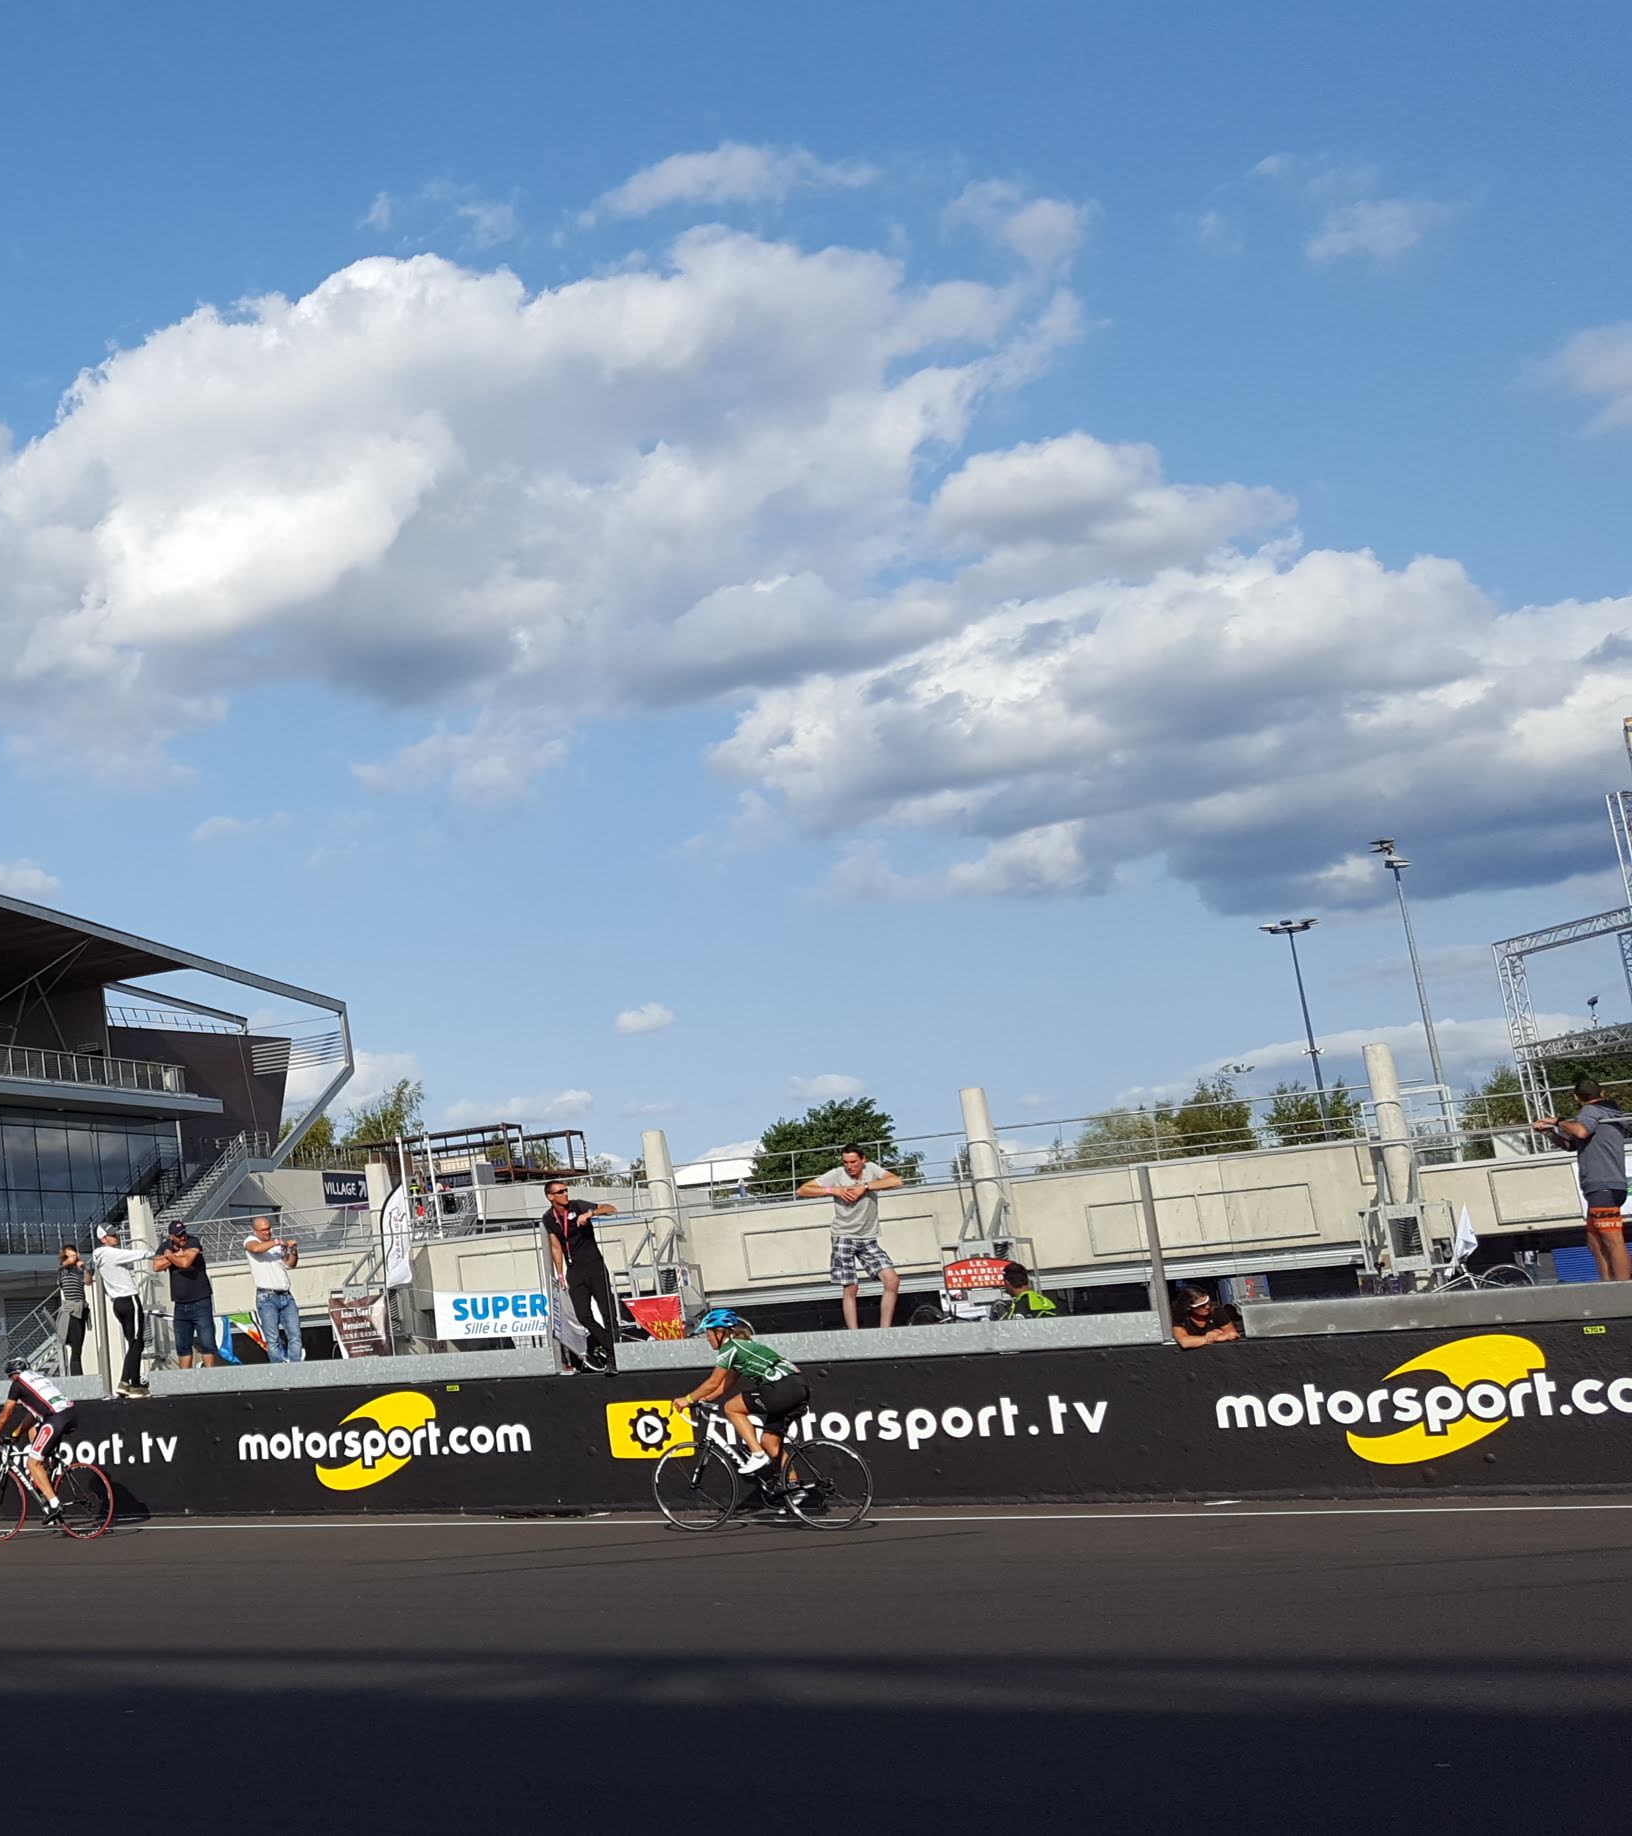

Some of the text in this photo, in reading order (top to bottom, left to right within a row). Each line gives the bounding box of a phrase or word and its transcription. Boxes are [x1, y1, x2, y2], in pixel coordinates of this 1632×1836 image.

[324, 1181, 357, 1196] VILLAGE
[969, 1260, 988, 1268] LES
[971, 1274, 1004, 1282] PERCH
[452, 1293, 549, 1322] SUPER
[464, 1321, 490, 1335] Sillé
[493, 1321, 508, 1334] Le
[238, 1420, 532, 1467] motorsport.com
